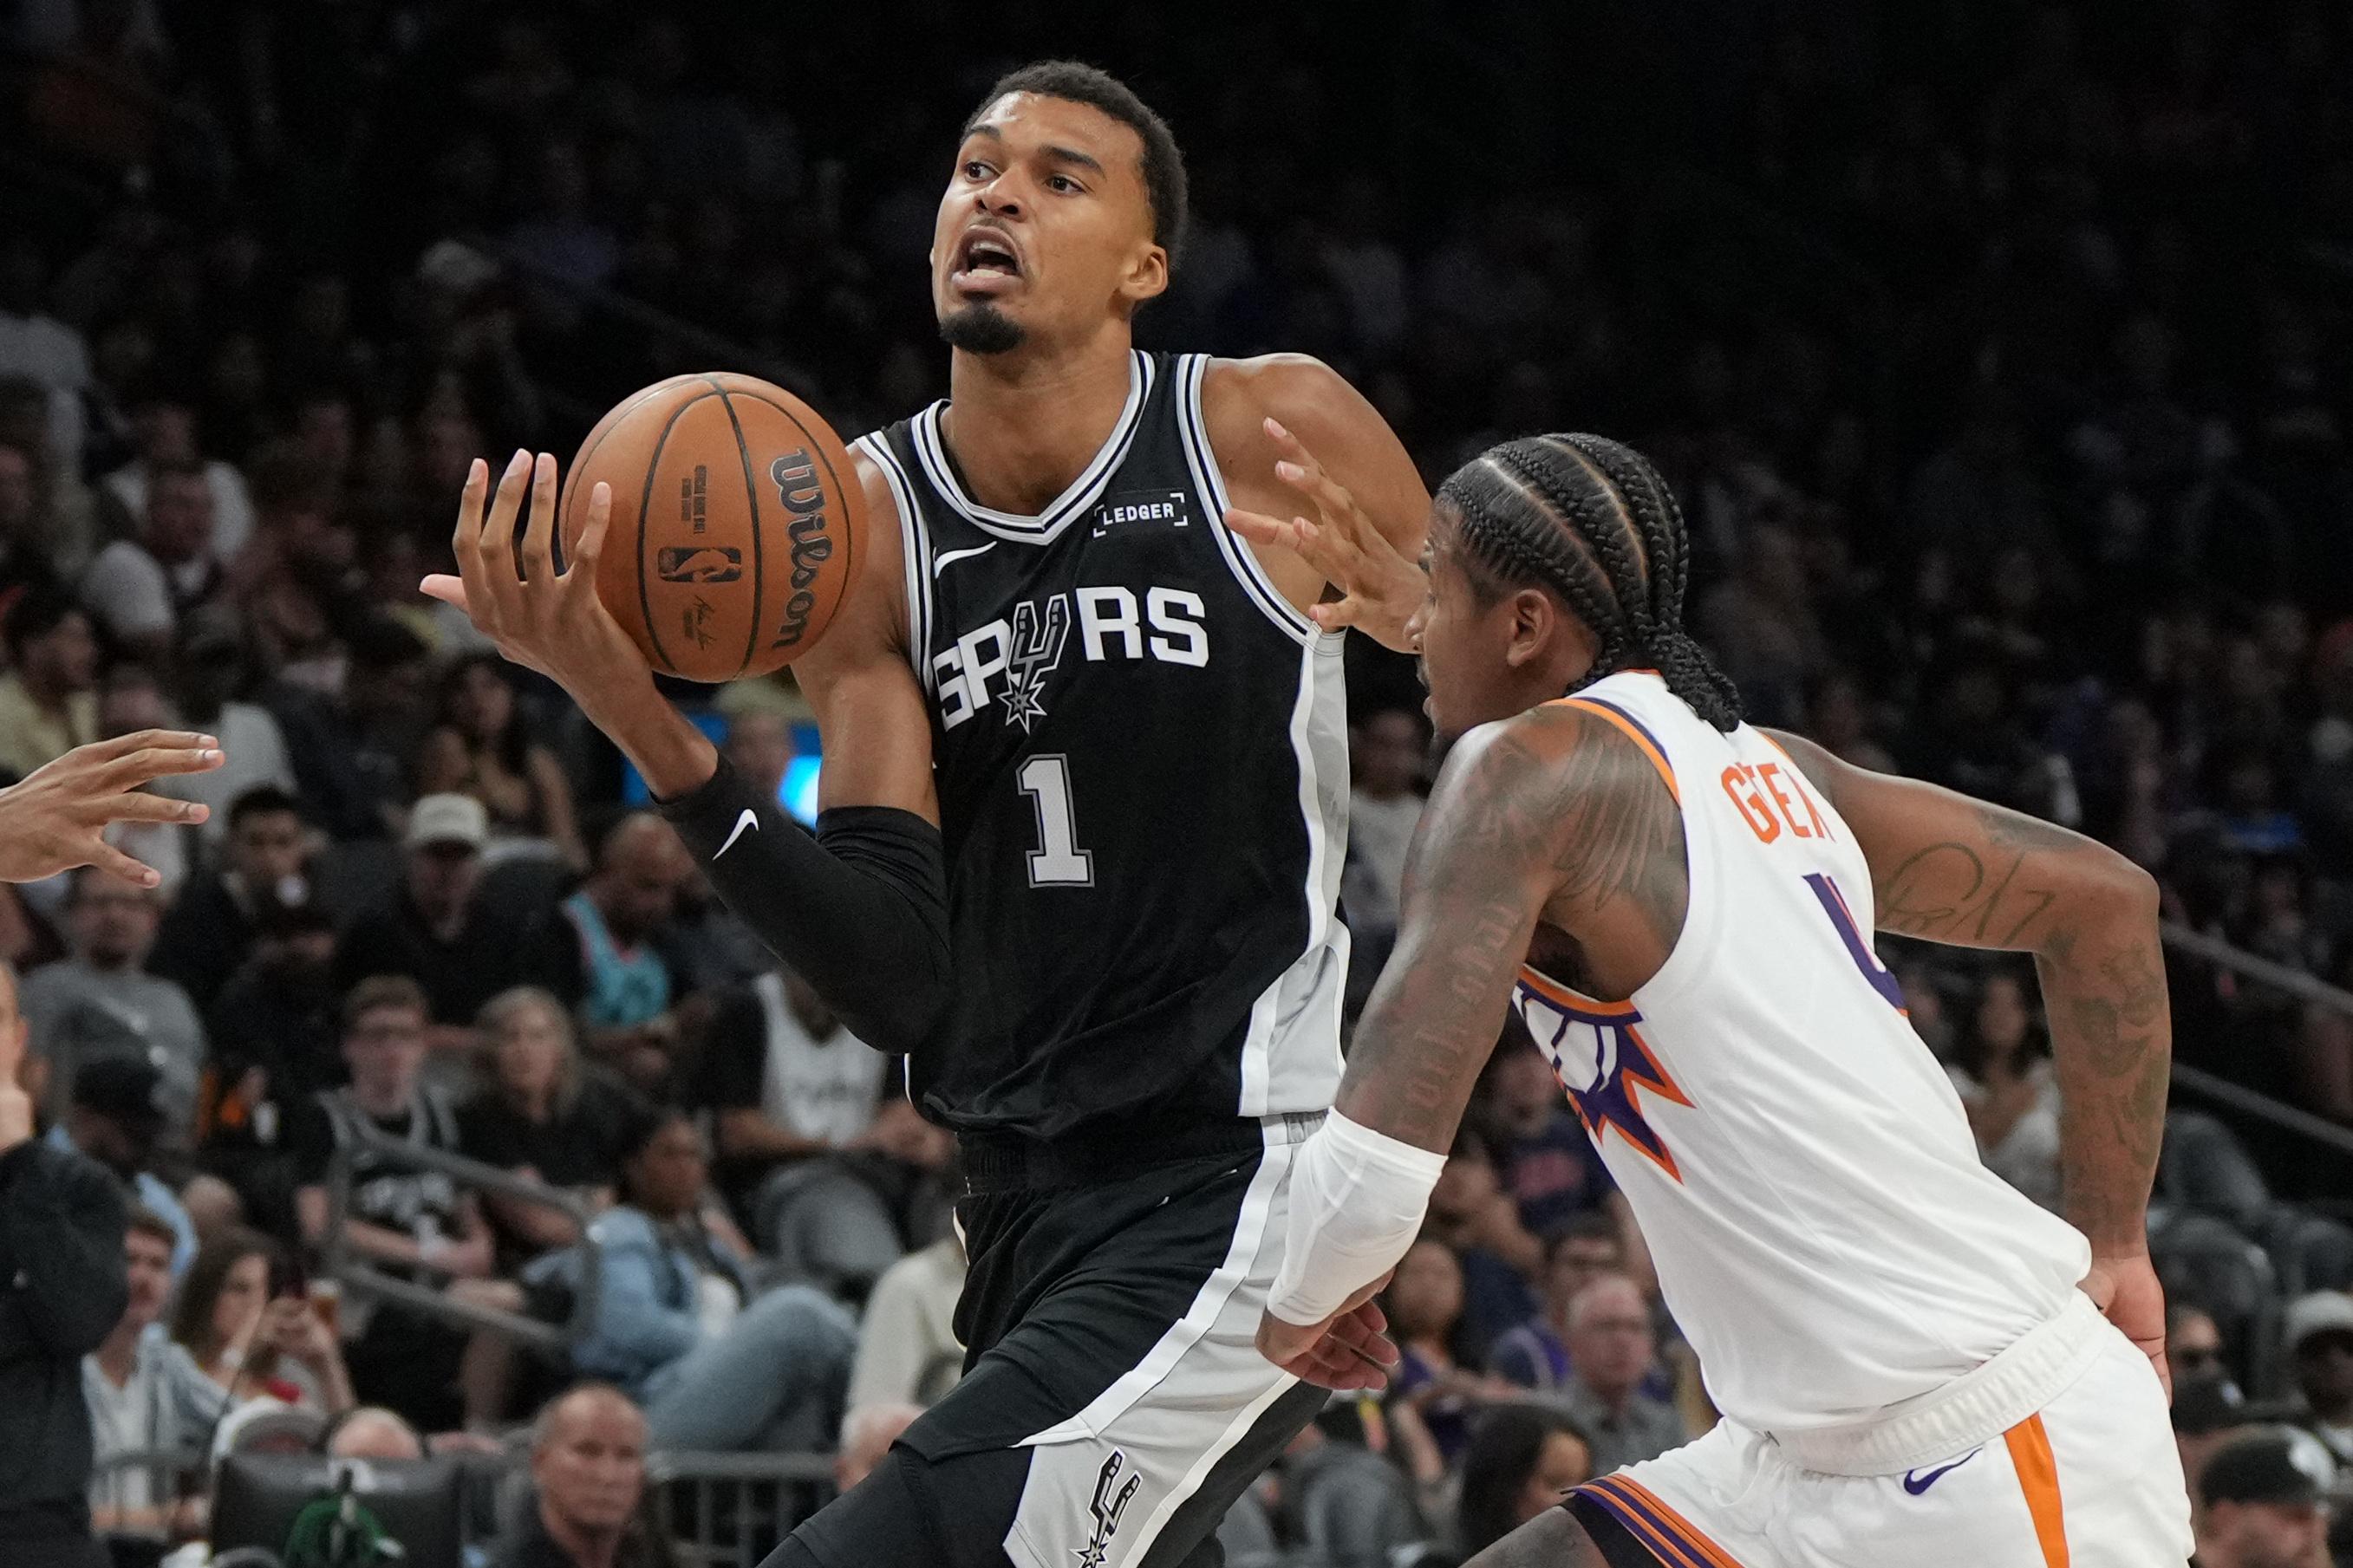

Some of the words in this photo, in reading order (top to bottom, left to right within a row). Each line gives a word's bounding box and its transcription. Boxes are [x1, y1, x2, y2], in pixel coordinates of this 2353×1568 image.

[770, 448, 832, 649] Wilson
[1103, 502, 1175, 525] LEDGER
[932, 586, 1209, 735] SPURS
[1015, 752, 1095, 888] 1
